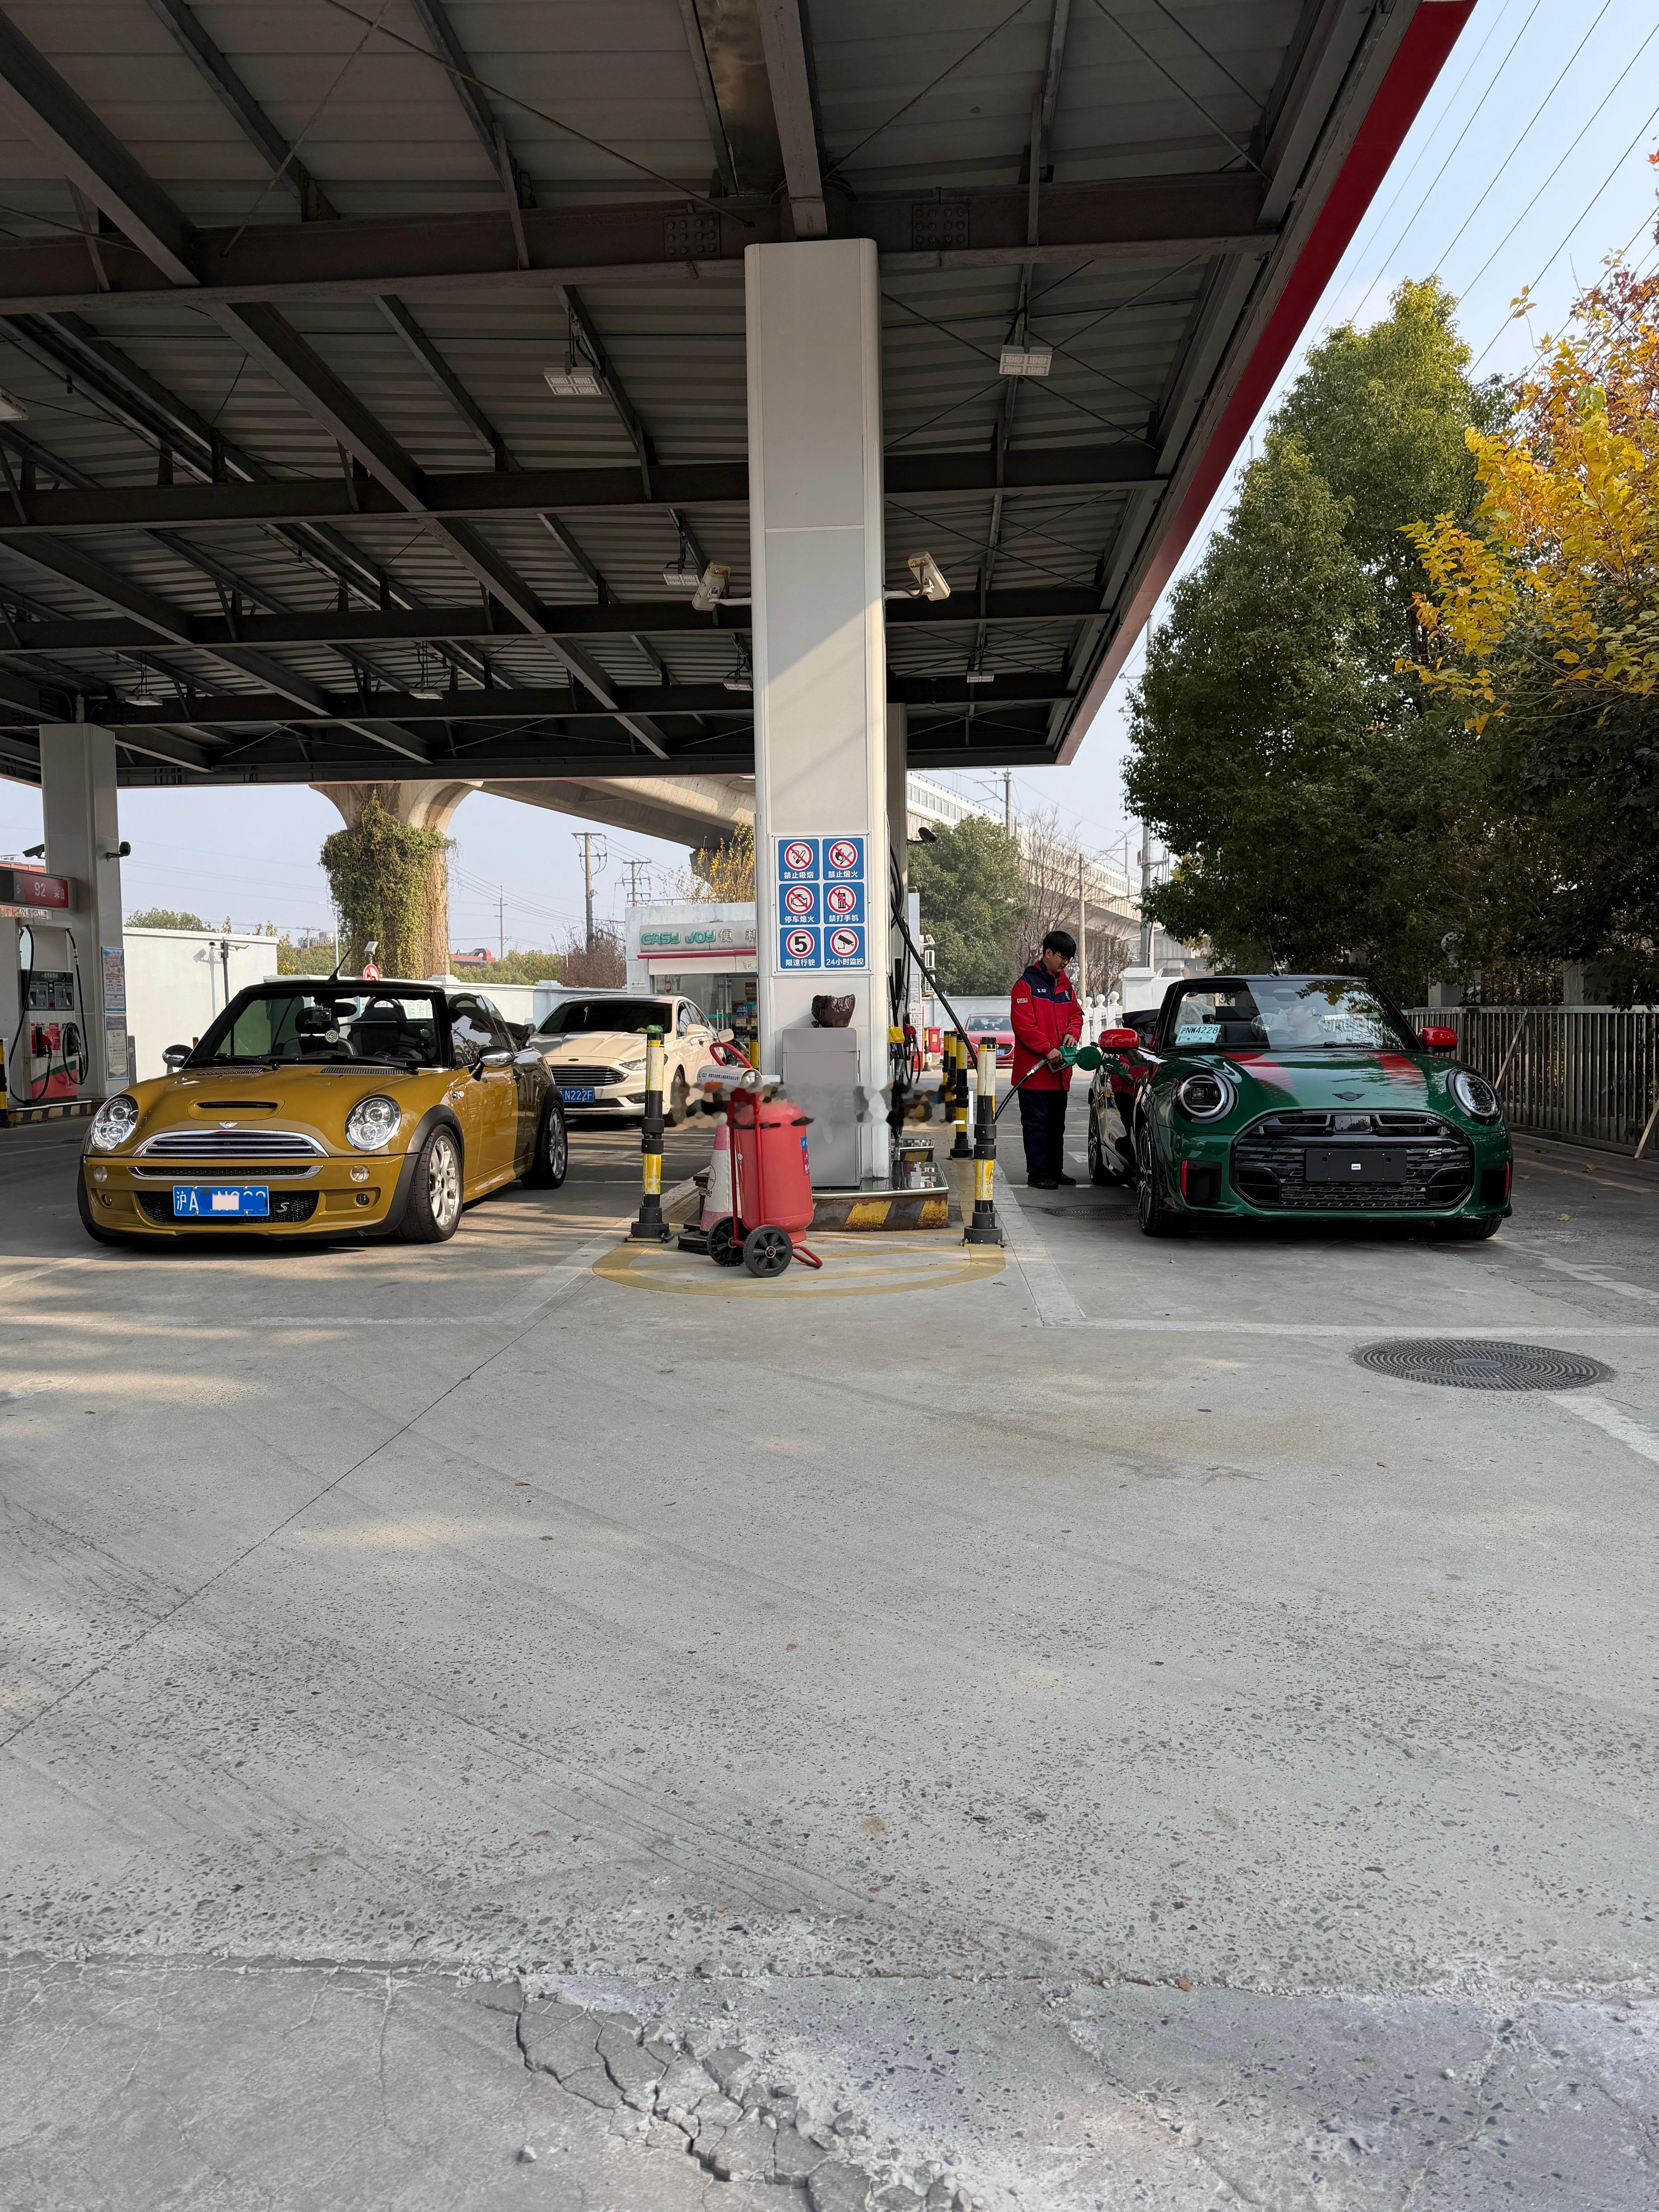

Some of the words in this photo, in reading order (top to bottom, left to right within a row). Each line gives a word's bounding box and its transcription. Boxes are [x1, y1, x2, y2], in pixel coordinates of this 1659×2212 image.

[34, 882, 46, 897] 92
[54, 886, 65, 900] 柴油
[641, 932, 680, 945] EASY
[685, 930, 716, 943] JOY
[794, 936, 807, 953] 5
[826, 958, 864, 966] 24小时监控
